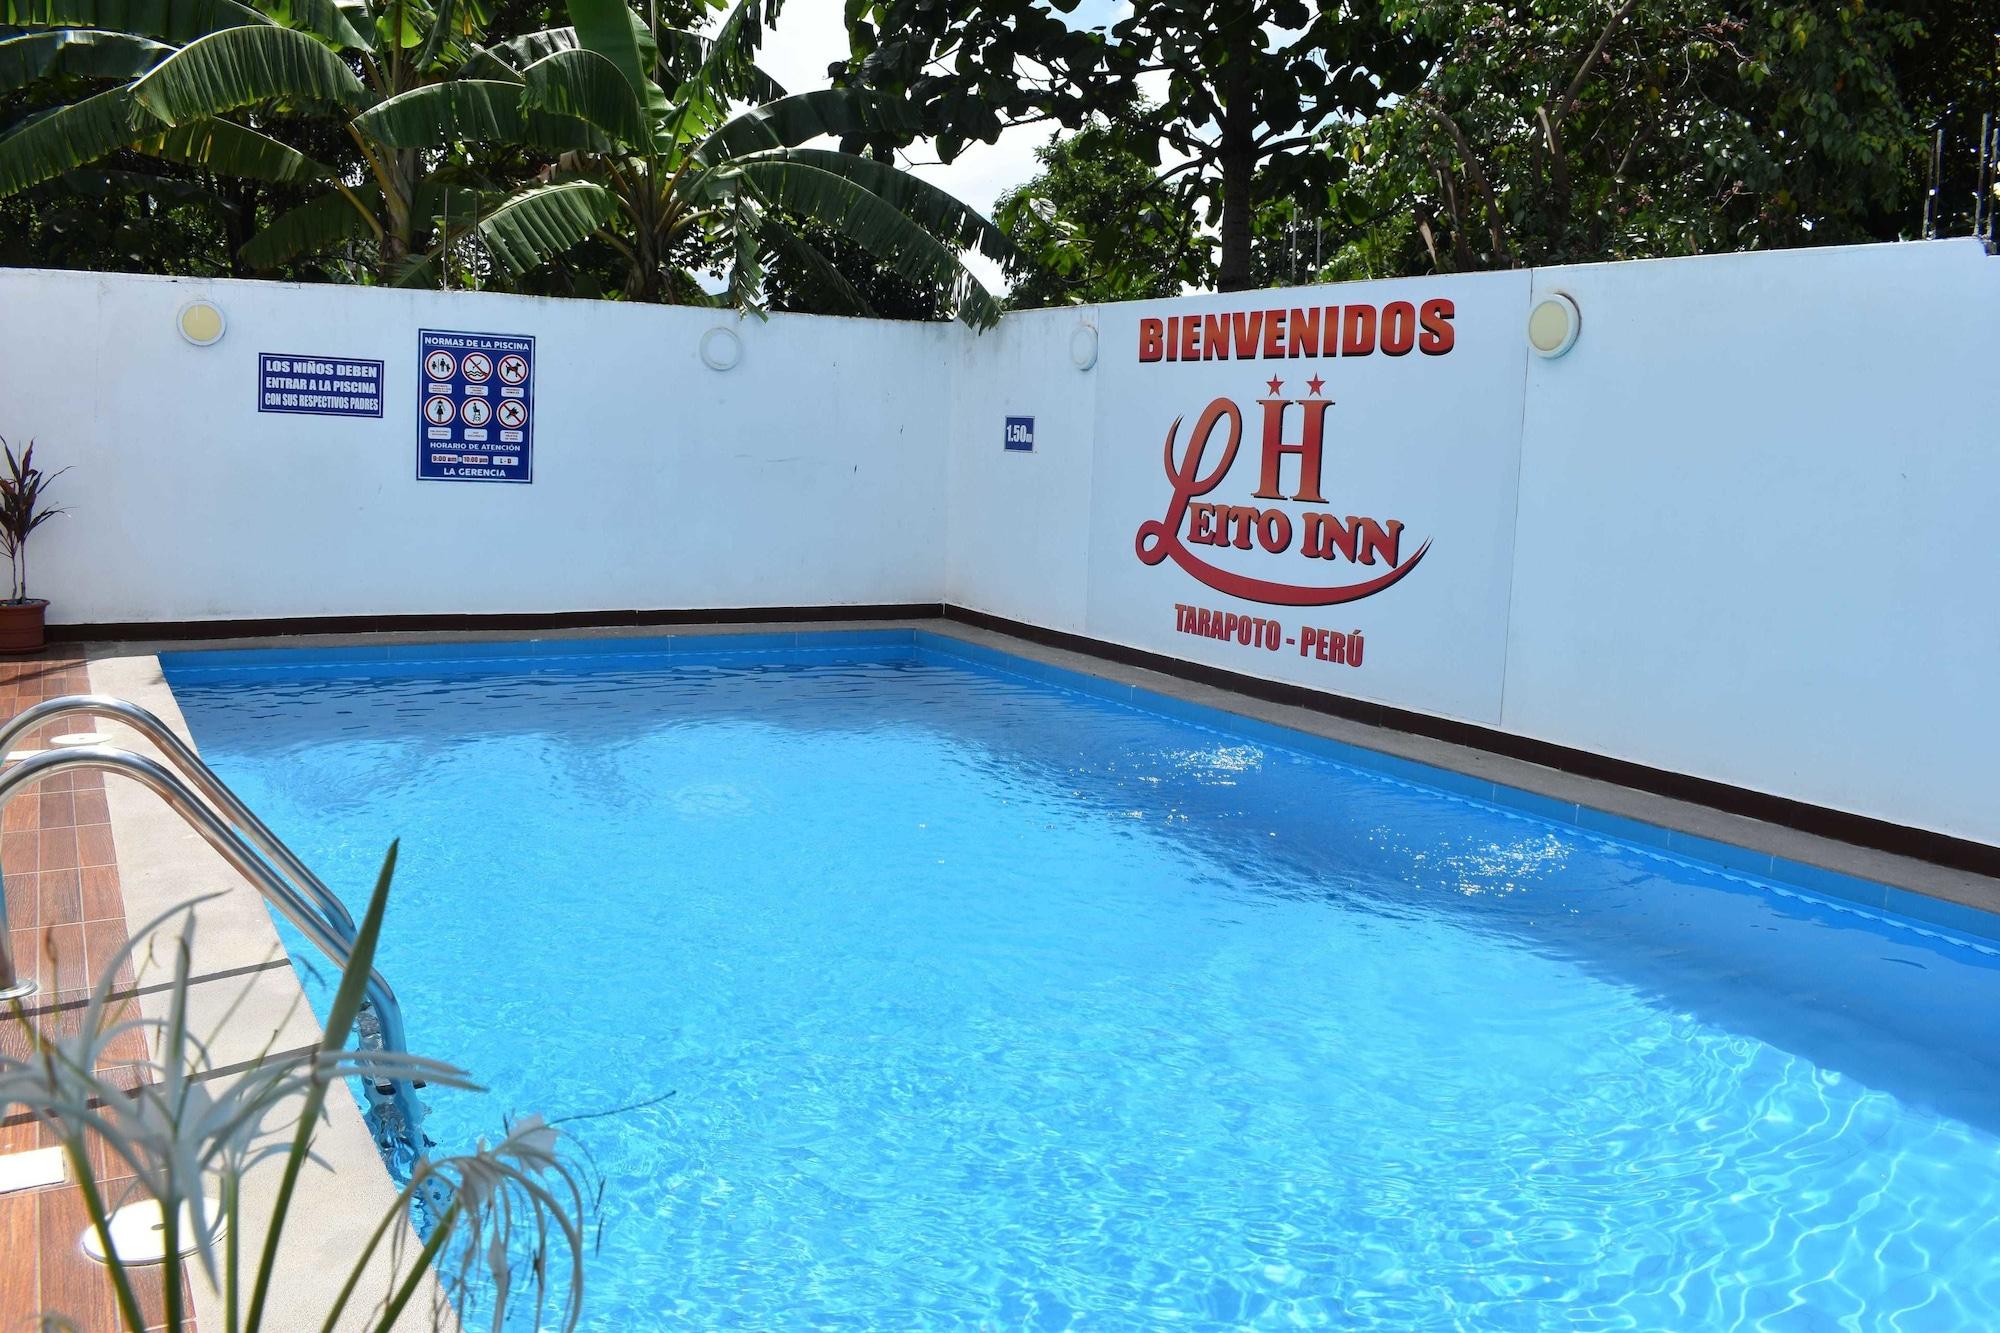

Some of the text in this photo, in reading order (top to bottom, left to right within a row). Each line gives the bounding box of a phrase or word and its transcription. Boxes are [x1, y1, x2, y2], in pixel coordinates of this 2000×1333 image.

[1138, 298, 1456, 363] BIENVENIDOS
[424, 336, 529, 350] NORMAS DE LA PISCINA
[265, 360, 377, 378] LOS NIÑOS DEBEN
[265, 377, 376, 394] ENTRAR A LA PISCINA
[264, 392, 379, 411] CON SUS RESPECTIVOS PADRES
[429, 441, 467, 450] HORARIO
[481, 442, 521, 452] ATENCIÓN
[1251, 399, 1336, 504] H
[443, 467, 506, 477] LA GERENCIA
[1300, 512, 1404, 569] INN
[1174, 604, 1365, 668] TARAPOTO - PERÚ
